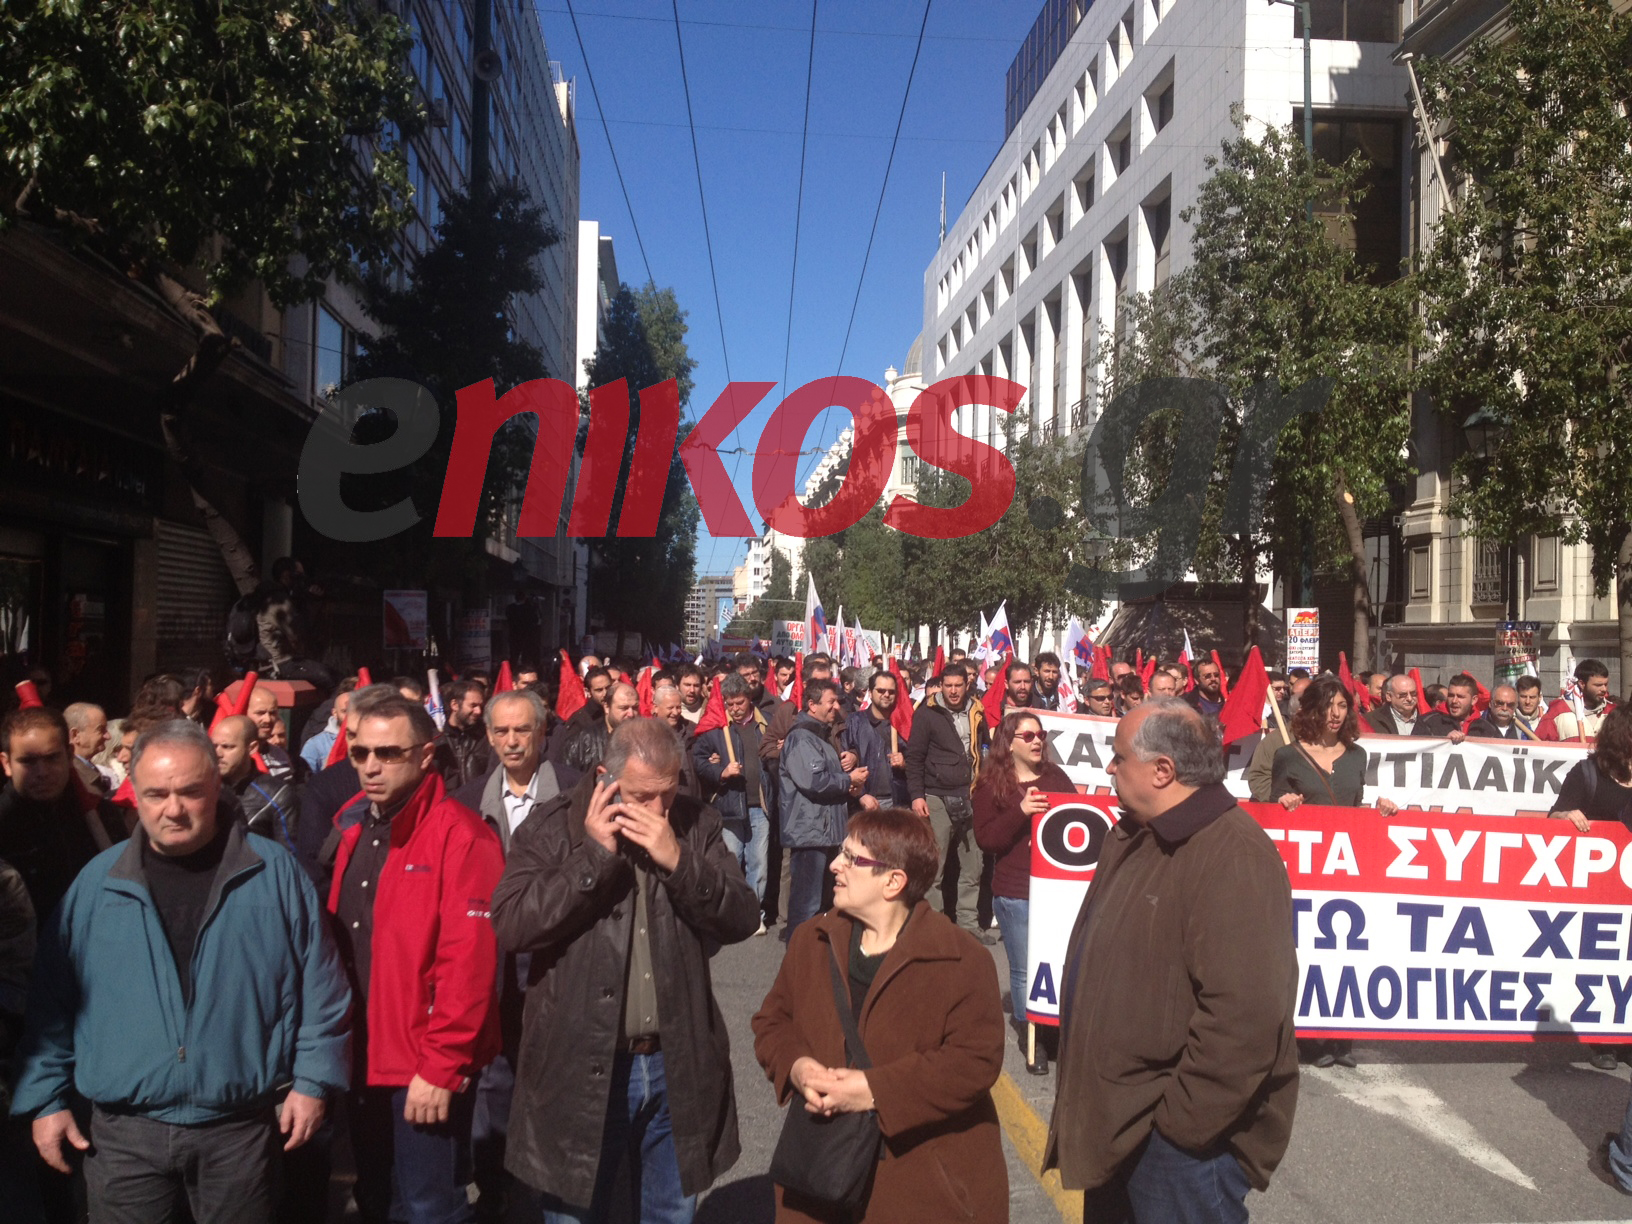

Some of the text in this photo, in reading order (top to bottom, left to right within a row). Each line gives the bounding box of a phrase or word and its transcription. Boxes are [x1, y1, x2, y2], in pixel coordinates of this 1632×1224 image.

[1397, 902, 1494, 956] ΤΑ
[1522, 909, 1632, 961] ΧΕ
[1298, 964, 1553, 1022] ΛΛΟΓΙΚΕΣ
